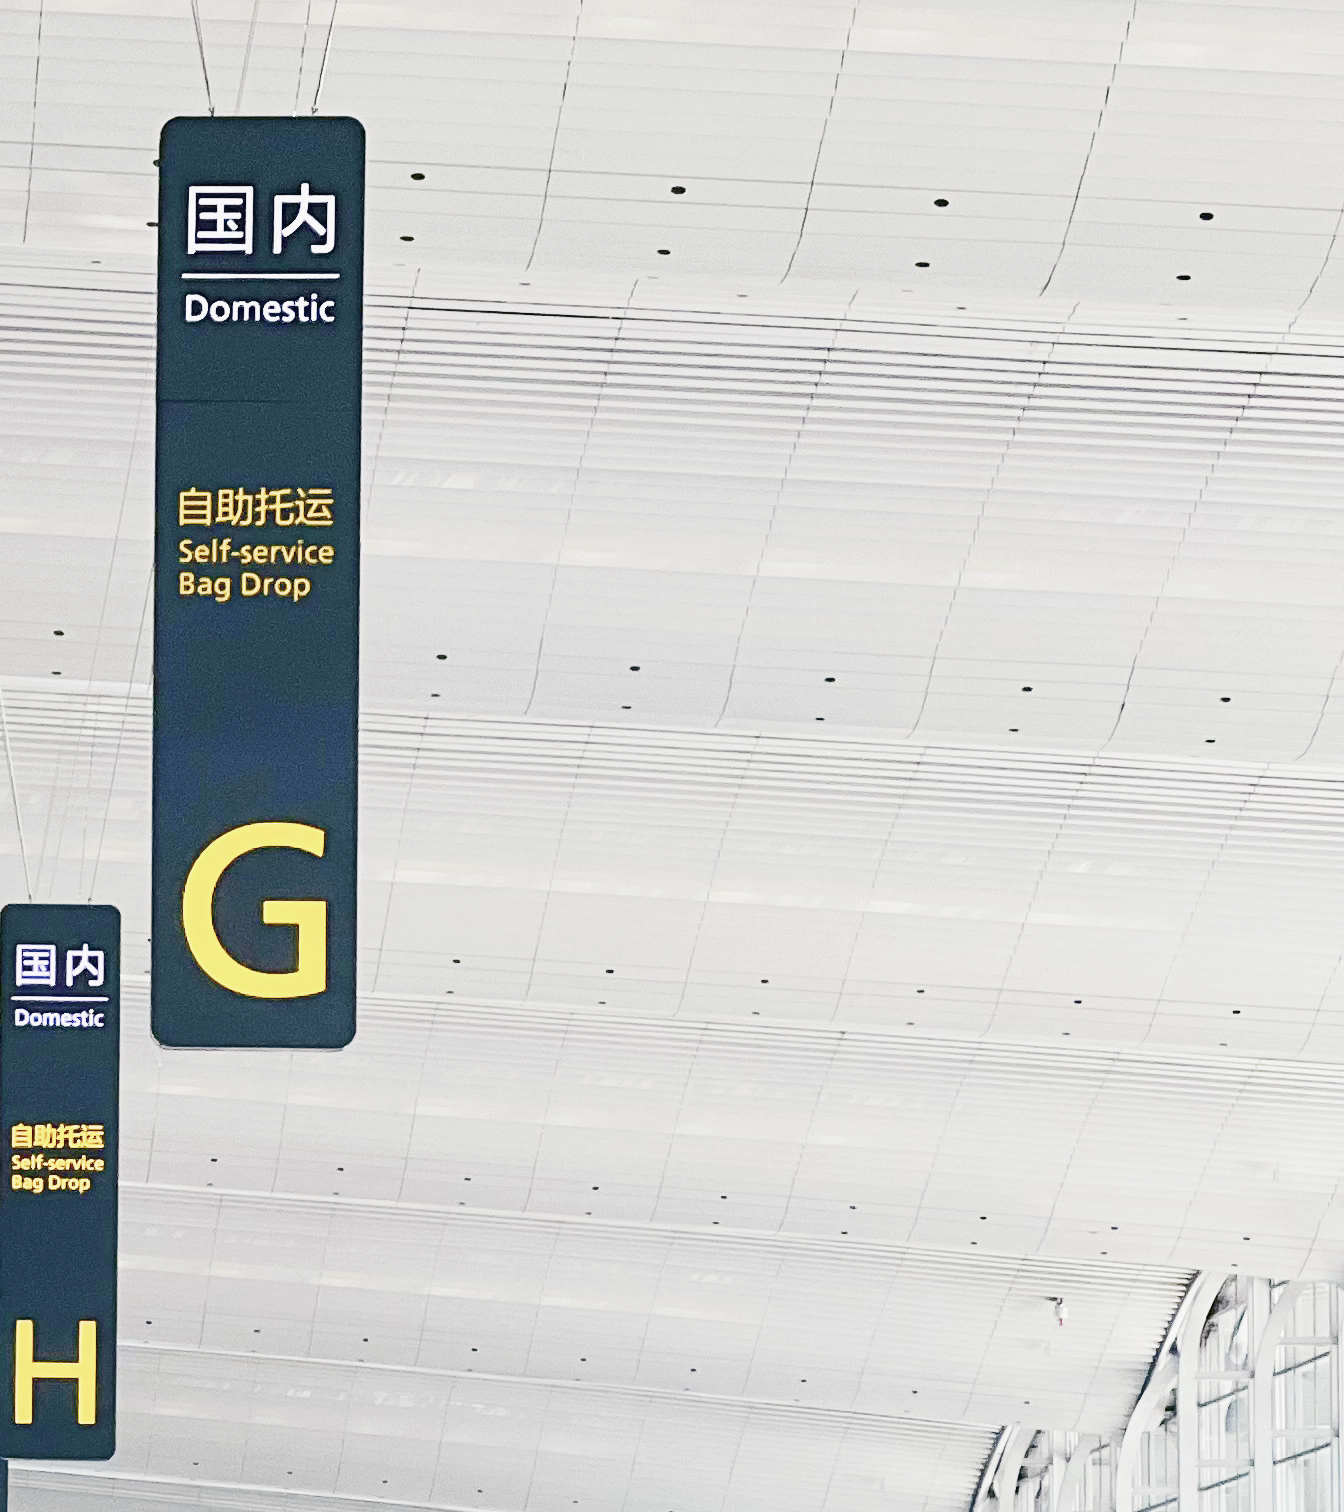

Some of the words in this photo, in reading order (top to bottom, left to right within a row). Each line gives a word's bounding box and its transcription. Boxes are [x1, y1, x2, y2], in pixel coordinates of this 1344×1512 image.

[187, 182, 336, 256] 国内
[185, 292, 335, 323] Domestic
[178, 487, 334, 527] 自助托运
[179, 537, 335, 564] Self-service
[179, 571, 233, 603] Bag
[242, 572, 311, 602] Drop
[181, 821, 328, 999] G
[15, 943, 105, 987] 国内
[14, 1008, 105, 1028] Domestic
[11, 1122, 105, 1149] 自助托运
[11, 1153, 105, 1172] Self-service
[11, 1174, 42, 1194] Bag
[45, 1174, 91, 1194] Drop
[14, 1319, 98, 1425] H
